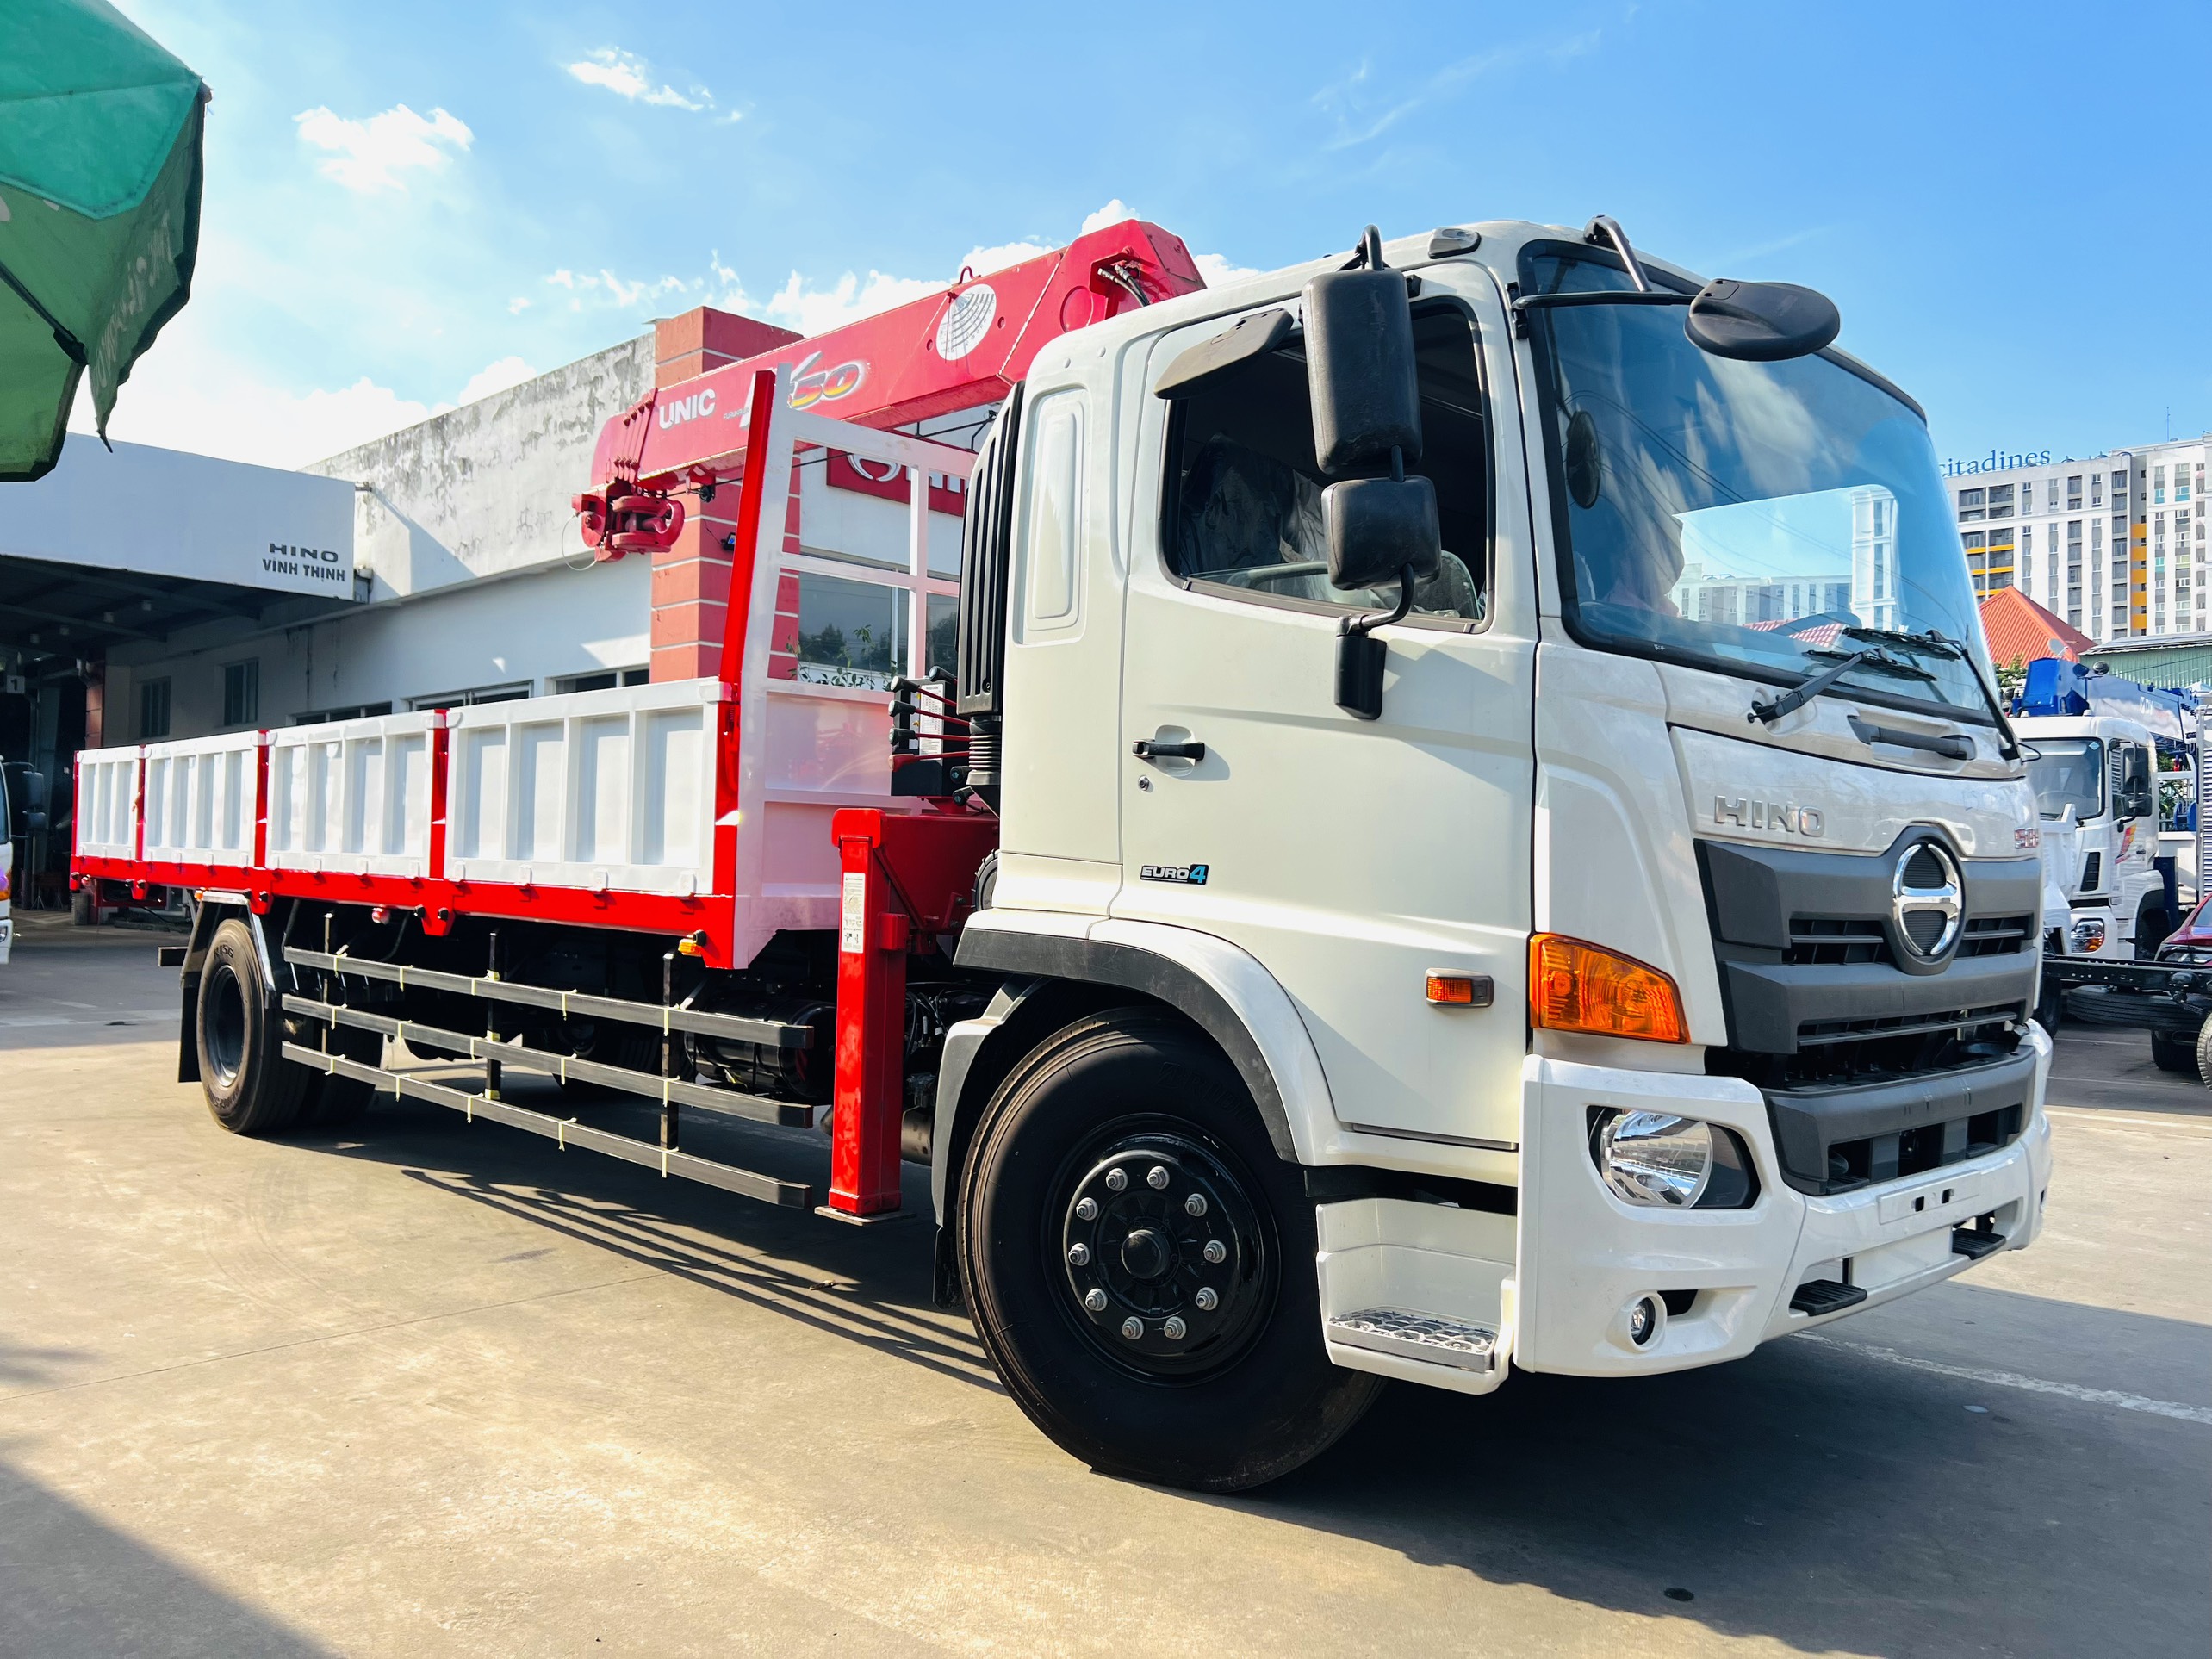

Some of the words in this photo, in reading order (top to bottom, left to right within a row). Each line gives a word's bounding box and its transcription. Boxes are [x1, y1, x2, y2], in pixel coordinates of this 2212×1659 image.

[658, 388, 716, 430] UNIC
[269, 543, 339, 562] HINO
[10, 678, 18, 691] 1
[1715, 795, 1825, 838] HINO
